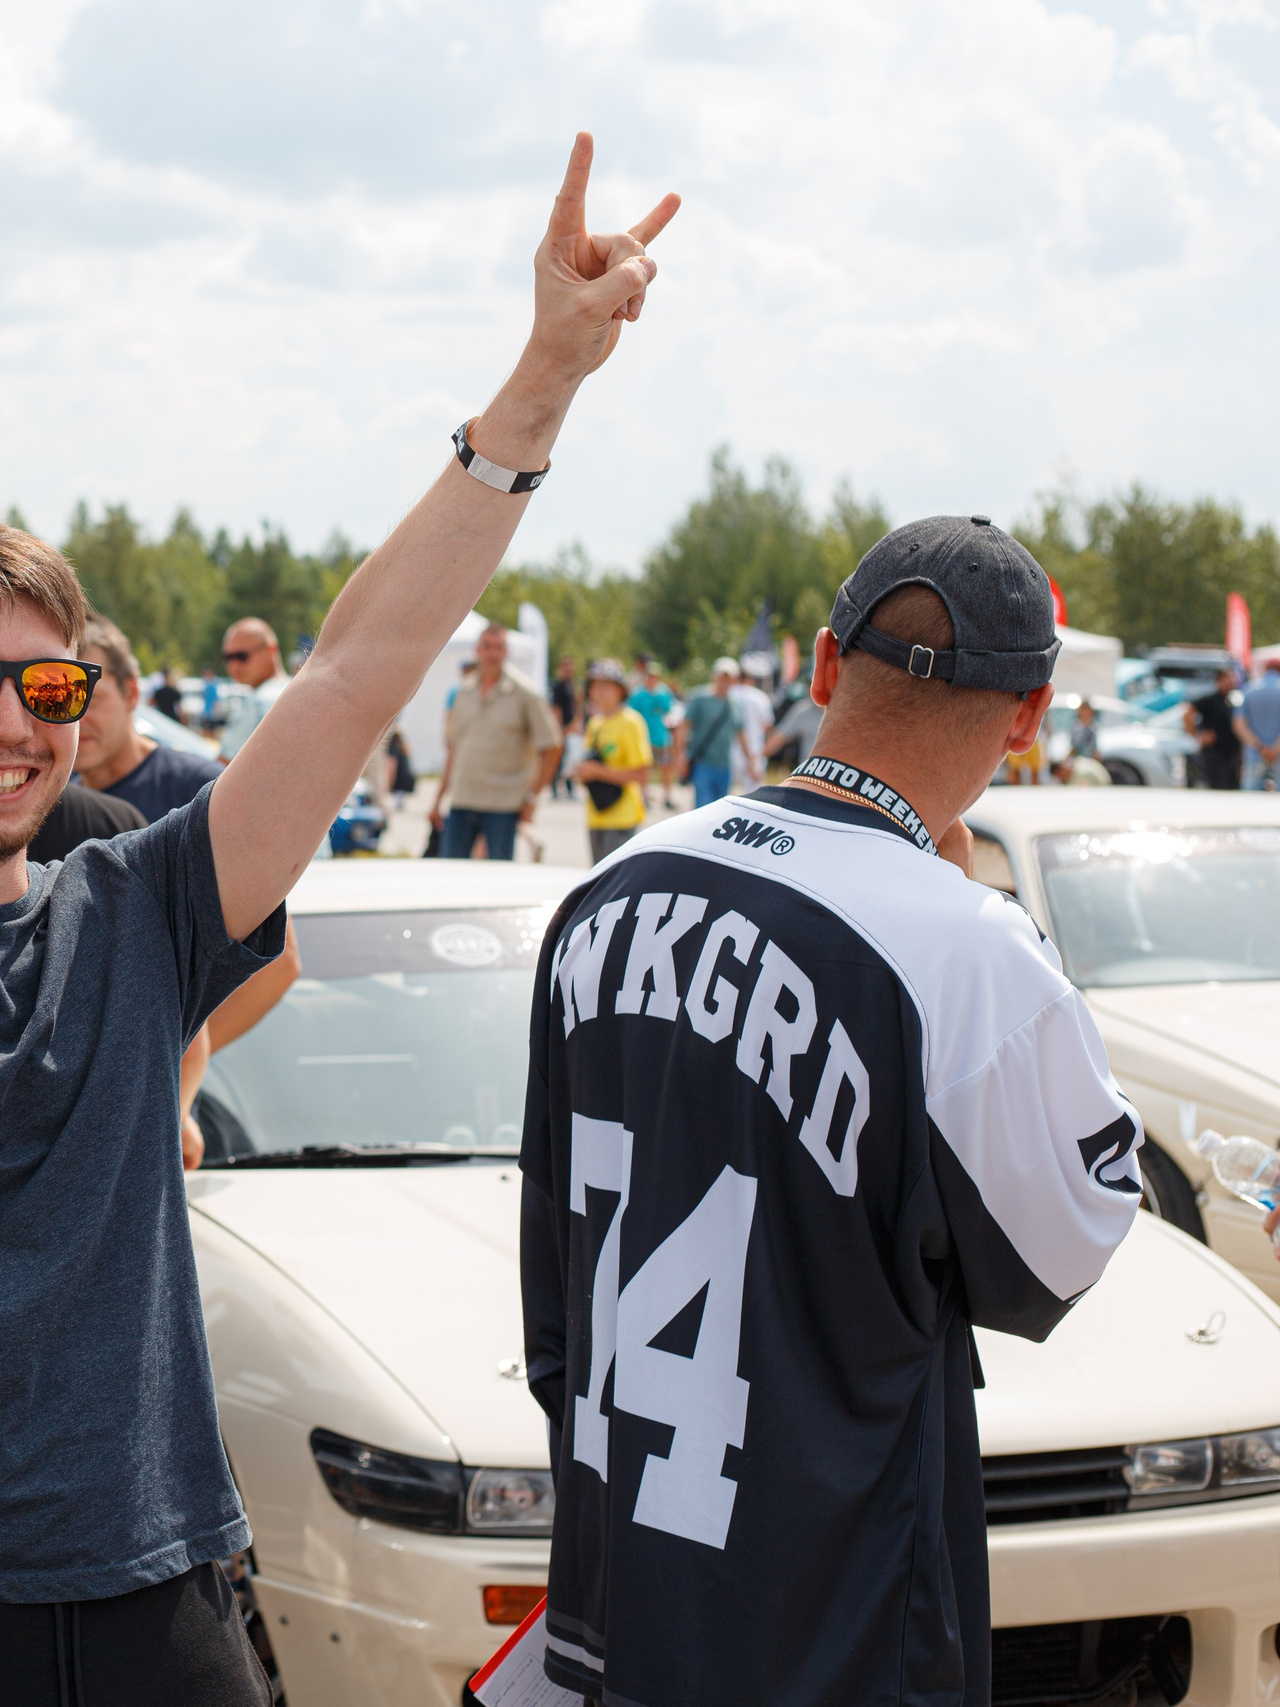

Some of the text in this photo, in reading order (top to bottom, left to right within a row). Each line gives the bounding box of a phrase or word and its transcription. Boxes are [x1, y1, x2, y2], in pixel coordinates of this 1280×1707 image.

[803, 757, 861, 788] AUTO
[859, 776, 941, 859] WEEKEN
[551, 892, 870, 1198] NKGRD
[569, 1111, 759, 1551] 74
